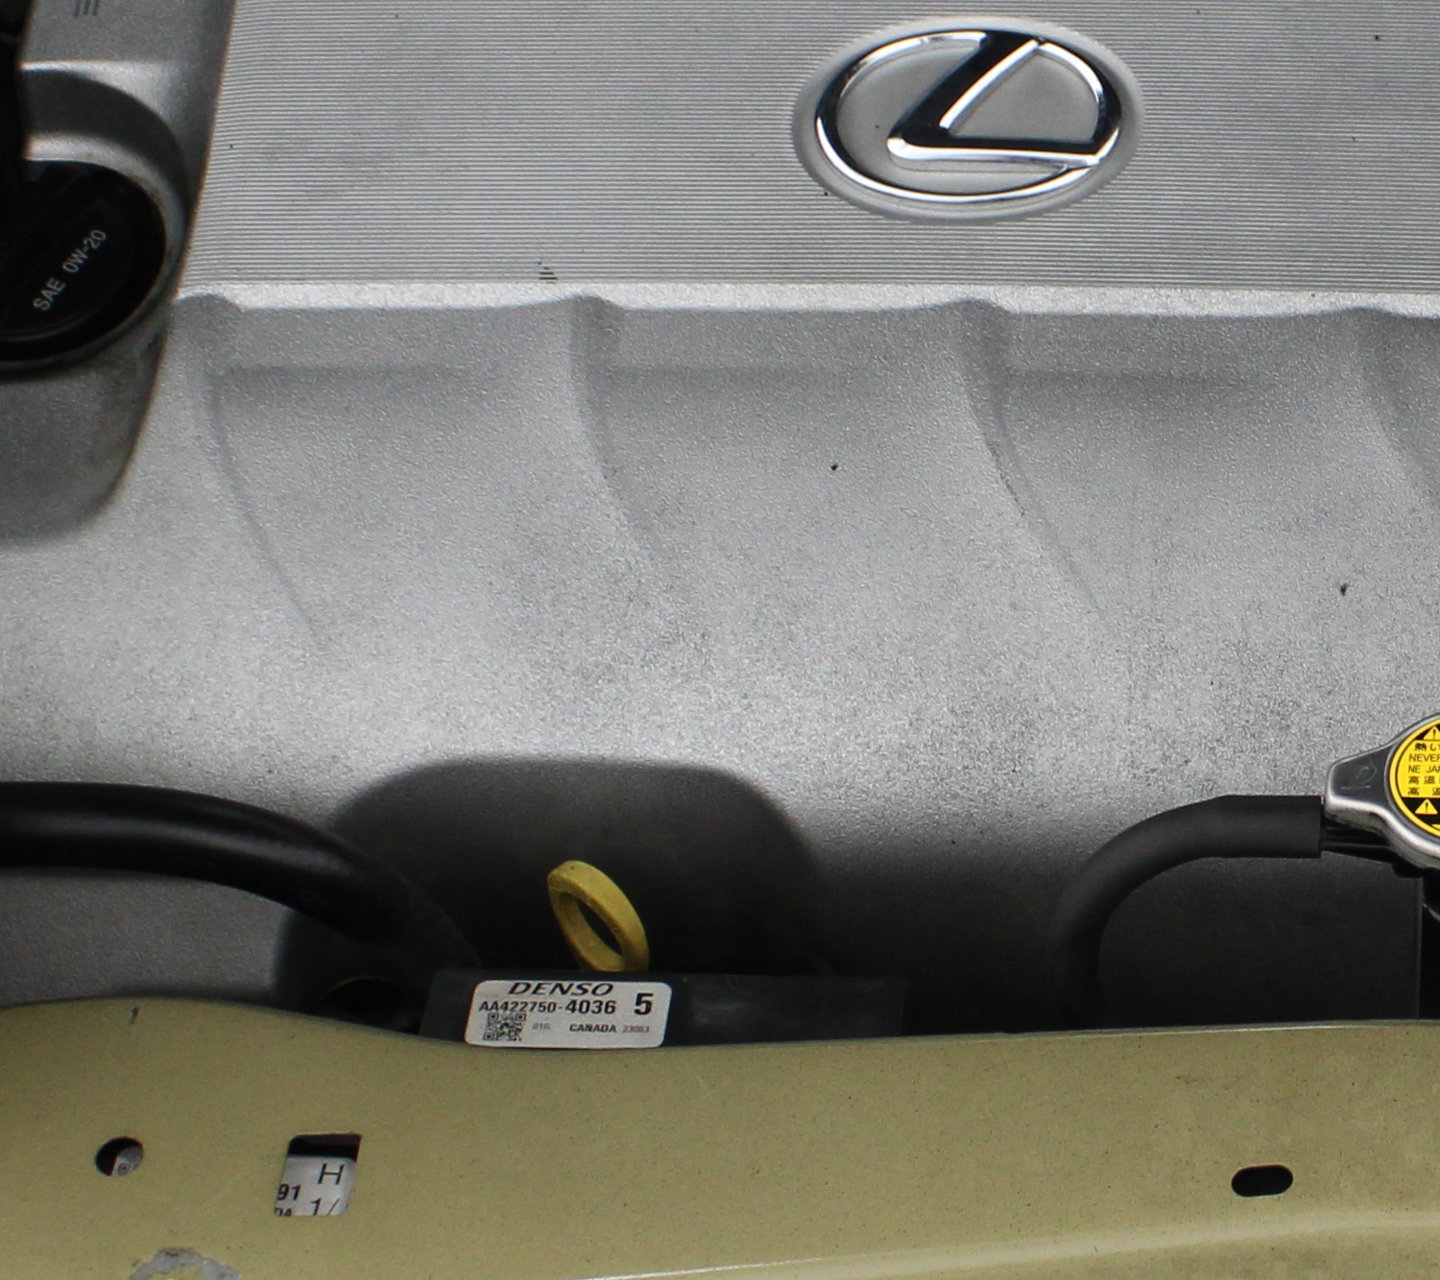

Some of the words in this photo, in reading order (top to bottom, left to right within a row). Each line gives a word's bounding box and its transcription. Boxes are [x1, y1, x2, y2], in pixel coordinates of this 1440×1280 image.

[32, 277, 66, 311] SAE
[62, 229, 108, 273] 0W-20
[1408, 765, 1421, 774] NE
[509, 982, 613, 996] DENSO
[479, 999, 616, 1015] AA422750-4036
[634, 992, 654, 1016] 5
[569, 1023, 617, 1033] CANADA
[318, 1163, 345, 1186] H
[277, 1183, 301, 1201] 91
